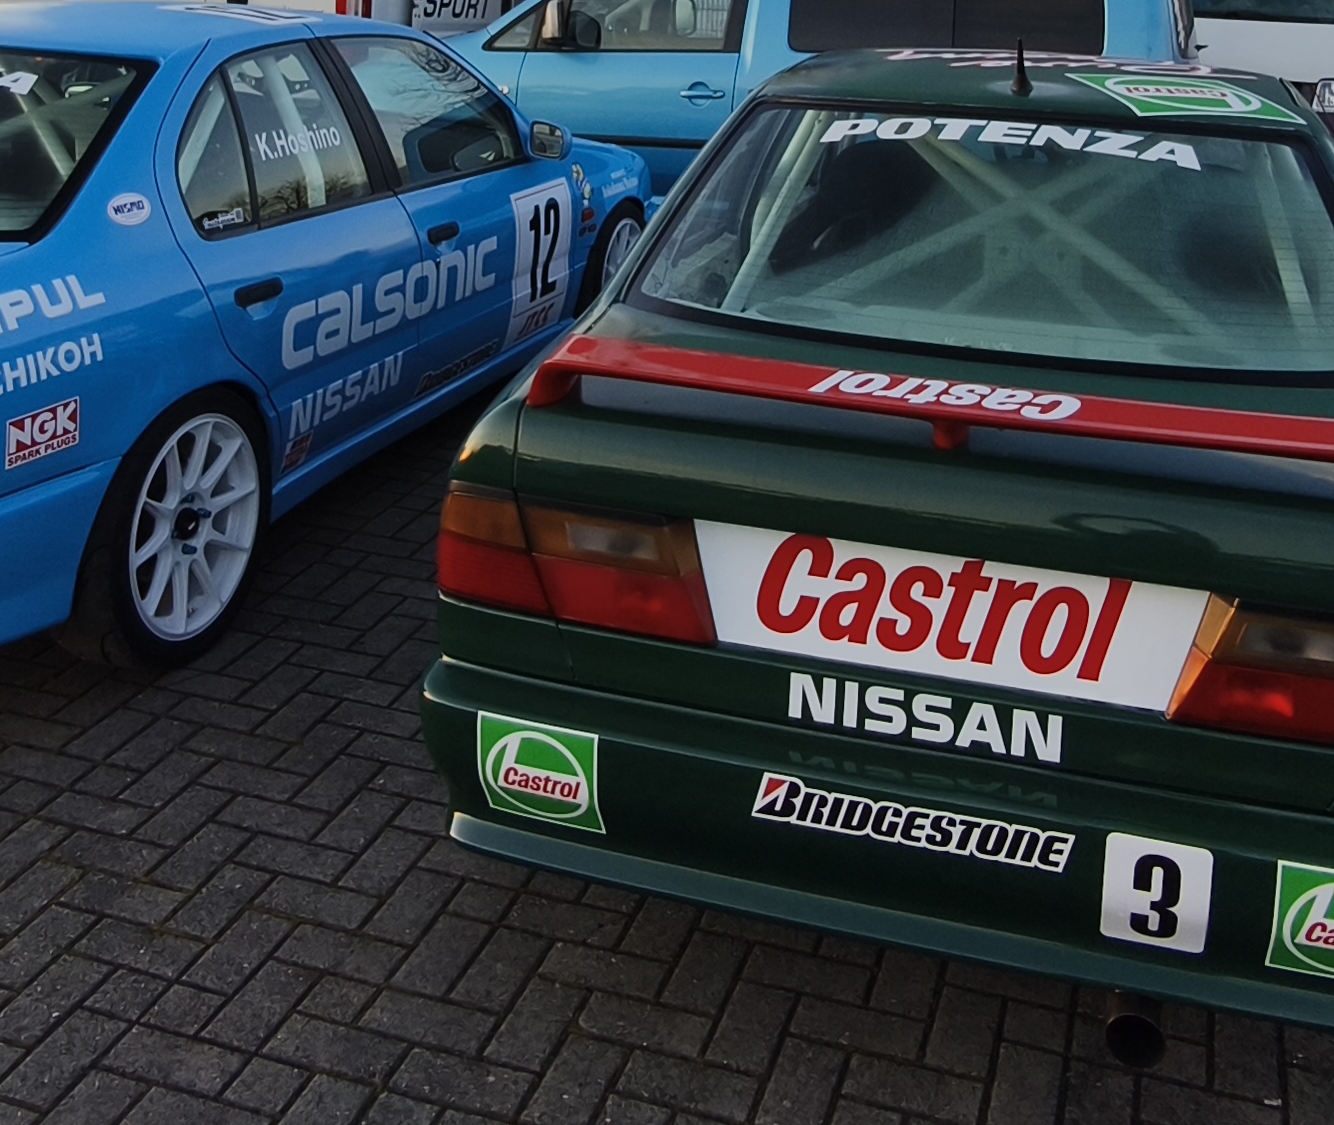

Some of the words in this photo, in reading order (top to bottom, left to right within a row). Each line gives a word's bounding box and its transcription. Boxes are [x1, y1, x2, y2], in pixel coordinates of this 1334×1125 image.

[1124, 85, 1228, 99] Castrol
[255, 123, 341, 161] K.Hoshino
[820, 117, 1202, 171] POTENZA
[112, 200, 145, 216] NISMO
[529, 197, 560, 303] 12
[289, 351, 404, 440] NISSAN
[807, 369, 1083, 421] Castrol
[7, 445, 42, 467] SPARK
[44, 434, 77, 456] PLUGS
[8, 400, 77, 454] NGK
[755, 532, 1133, 683] Castrol
[787, 671, 1065, 765] NISSAN
[501, 766, 583, 801] Castrol
[757, 775, 1071, 871] BRIDGESTONE
[1129, 853, 1183, 939] 3
